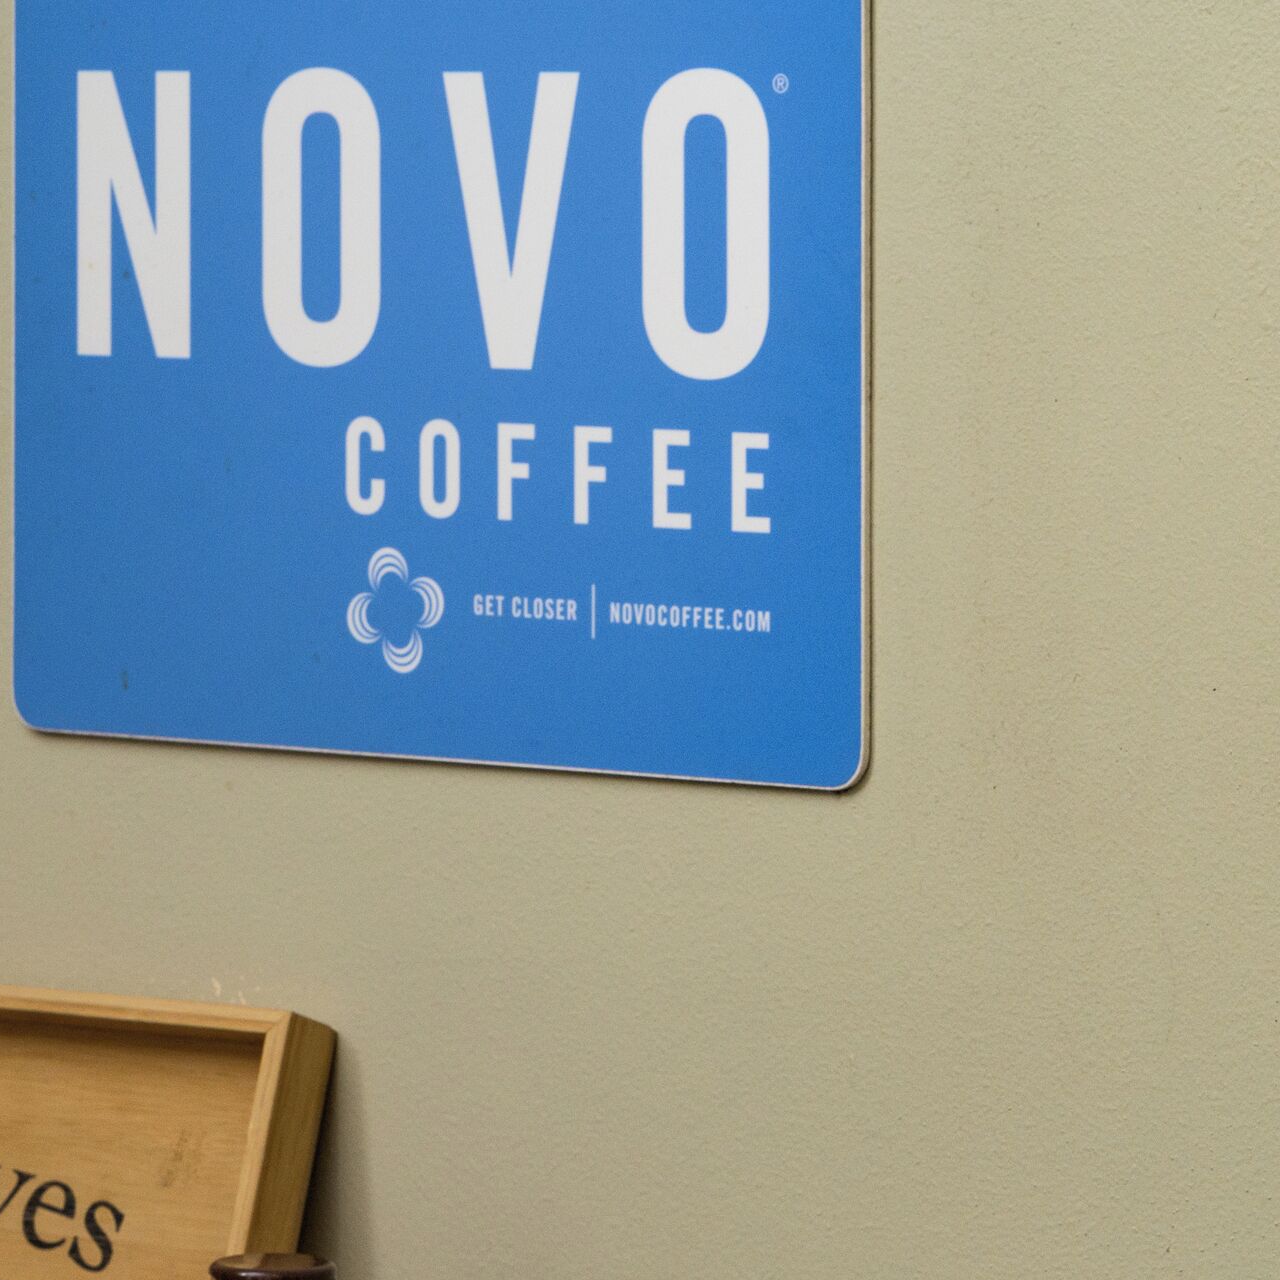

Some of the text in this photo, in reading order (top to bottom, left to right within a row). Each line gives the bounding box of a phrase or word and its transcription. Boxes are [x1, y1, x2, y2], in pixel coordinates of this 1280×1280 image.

[77, 67, 770, 380] NOVO
[345, 415, 771, 534] COFFEE
[473, 594, 578, 622] GET CLOSER
[609, 602, 771, 633] NOVOCOFFEE.COM
